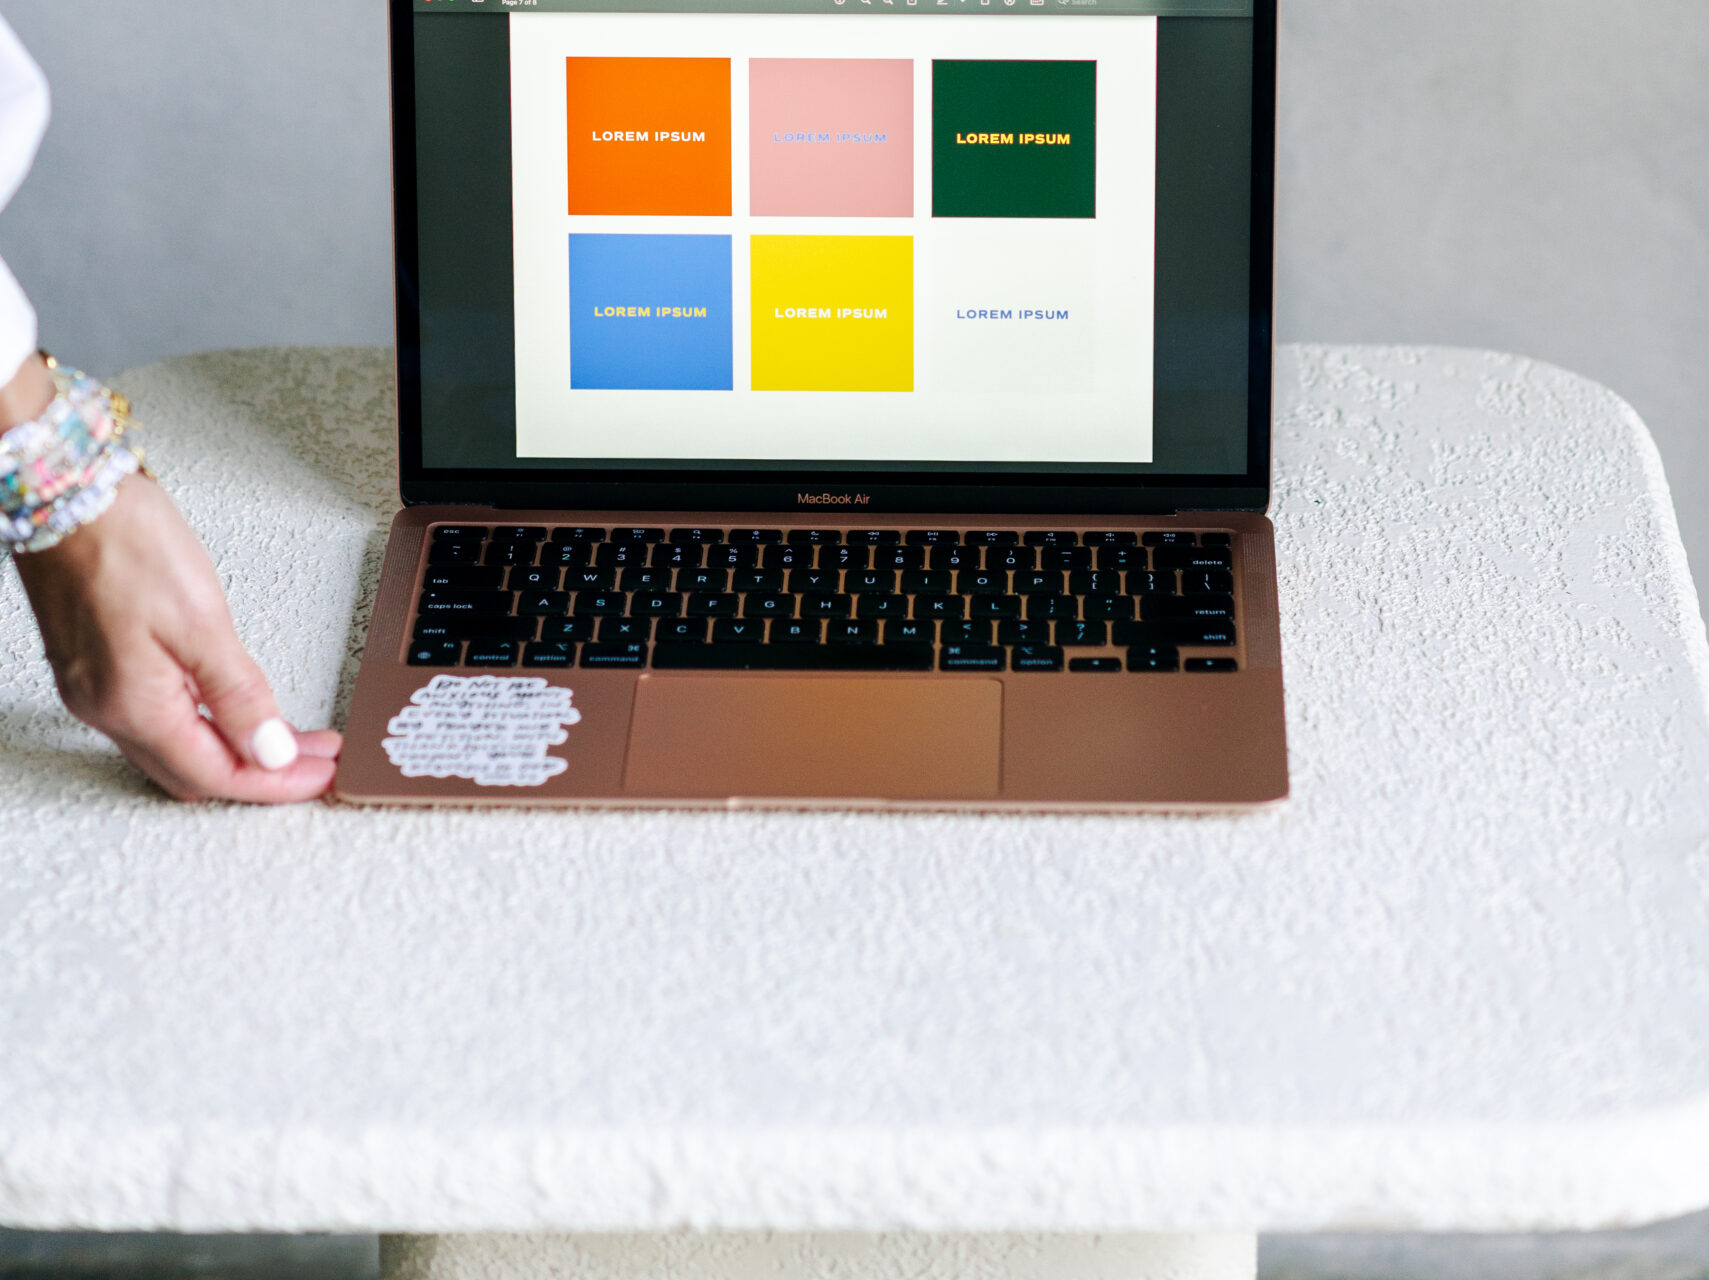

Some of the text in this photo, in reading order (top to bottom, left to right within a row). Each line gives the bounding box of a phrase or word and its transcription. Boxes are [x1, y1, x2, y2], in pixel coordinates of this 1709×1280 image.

[502, 0, 518, 7] Page
[592, 131, 705, 141] LOREM IPSUM
[774, 132, 887, 143] LOREM IPSUM
[957, 133, 1070, 144] LOREM IPSUM
[595, 307, 706, 317] LOREM IPSUM
[775, 308, 887, 318] LOREM IPSUM
[957, 310, 1068, 319] LOREM IPSUM
[798, 493, 870, 504] MacBook Air
[529, 574, 540, 582] Q
[677, 625, 687, 633] C
[790, 626, 800, 634] B
[903, 627, 916, 635] M
[1077, 623, 1085, 631] ?
